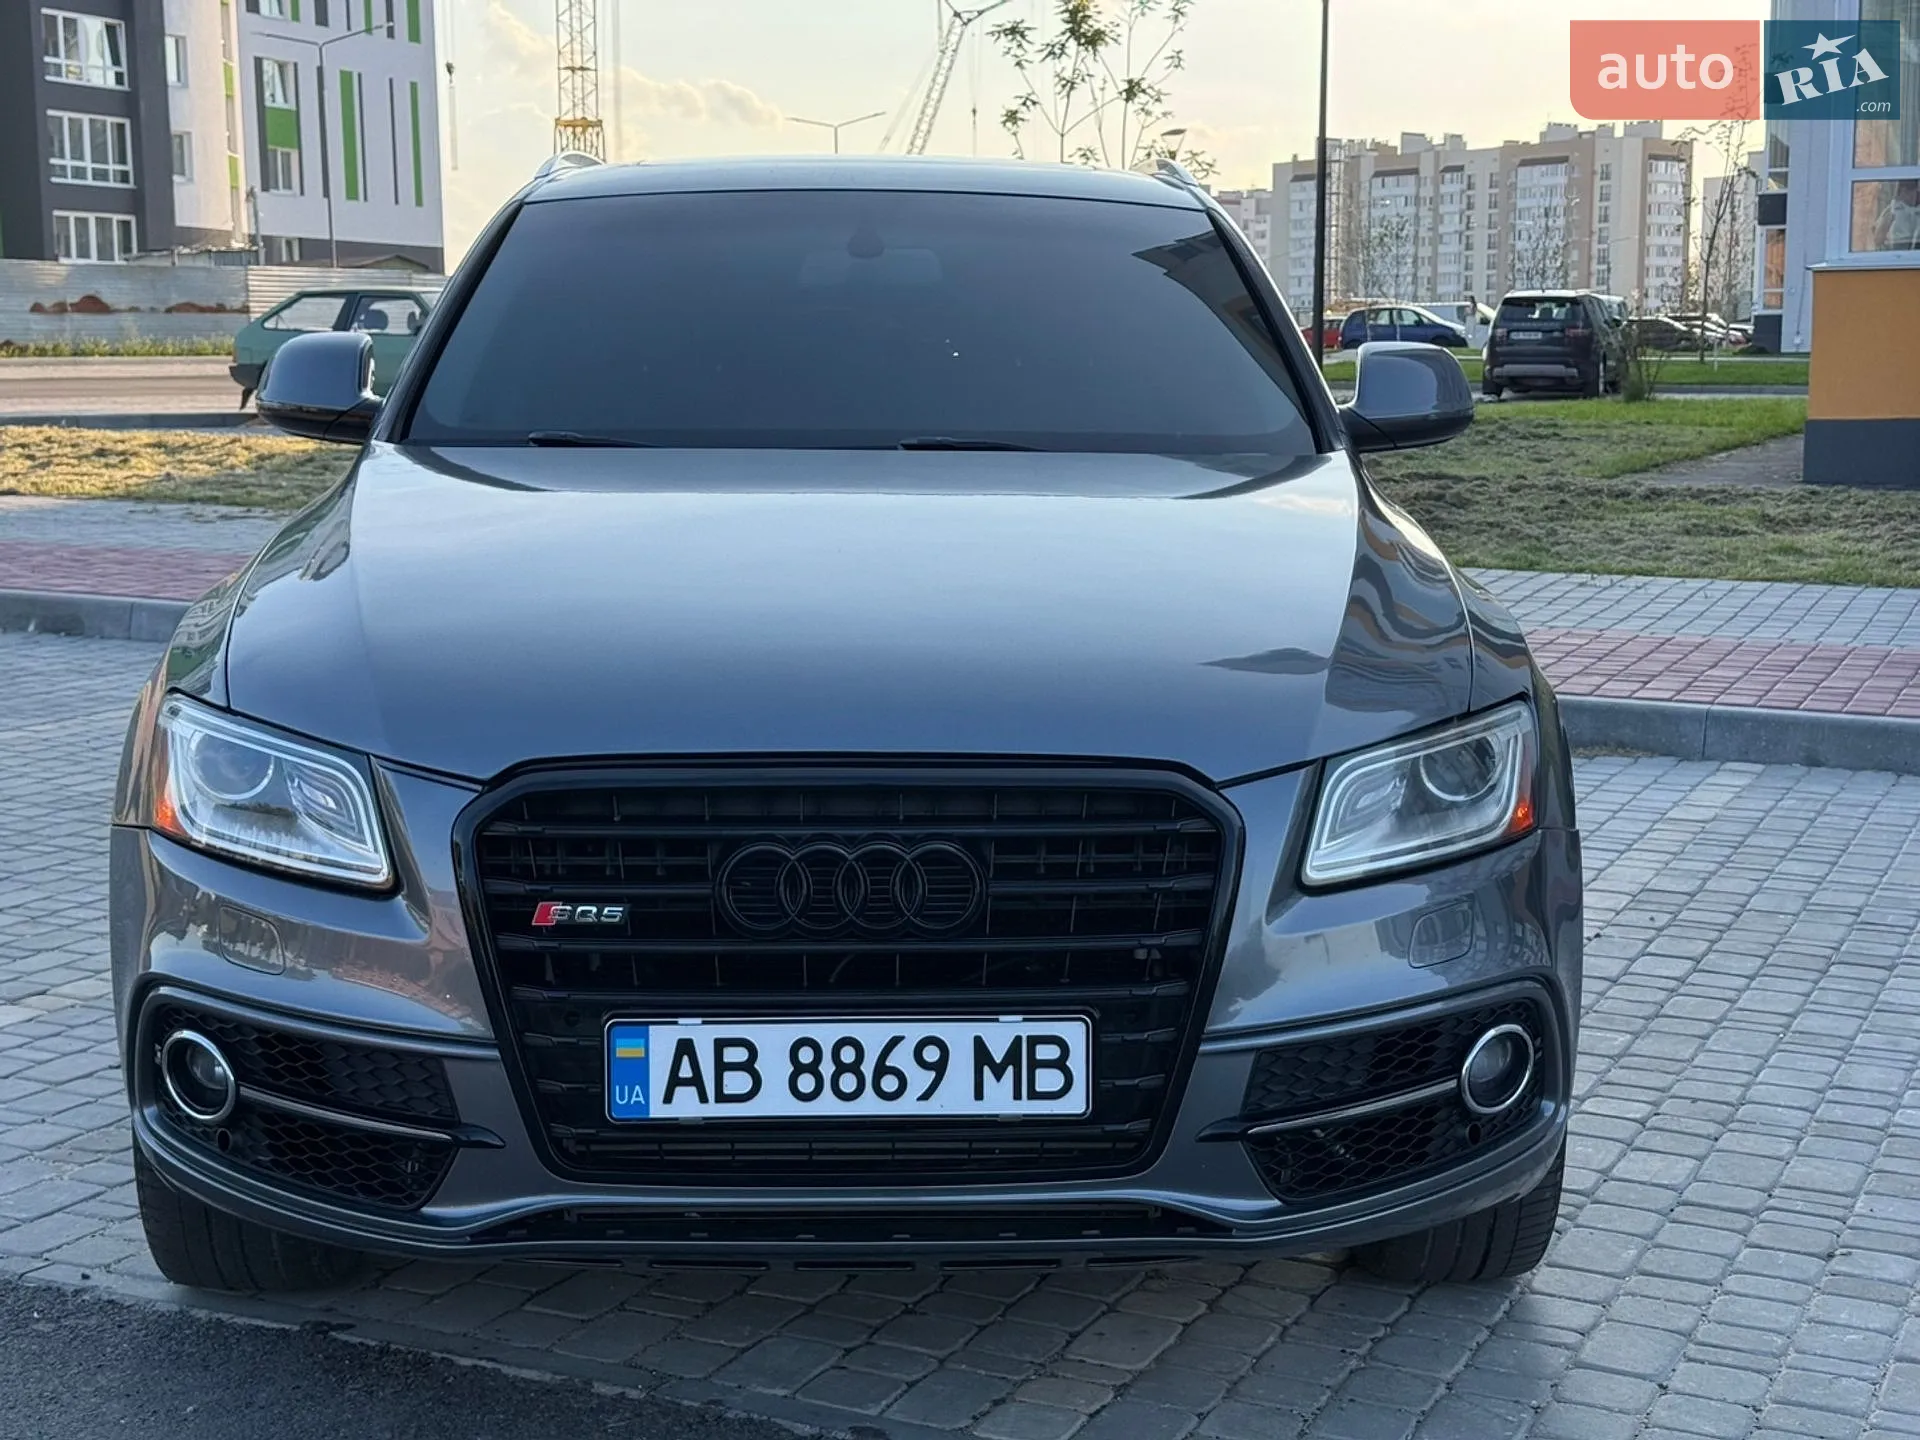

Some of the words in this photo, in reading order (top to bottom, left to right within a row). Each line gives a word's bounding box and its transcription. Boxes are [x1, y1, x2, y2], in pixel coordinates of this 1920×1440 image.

[549, 905, 624, 923] SQ5
[662, 1037, 763, 1104] AB
[788, 1035, 950, 1103] 8869
[973, 1034, 1075, 1101] MB
[615, 1085, 646, 1105] UA
